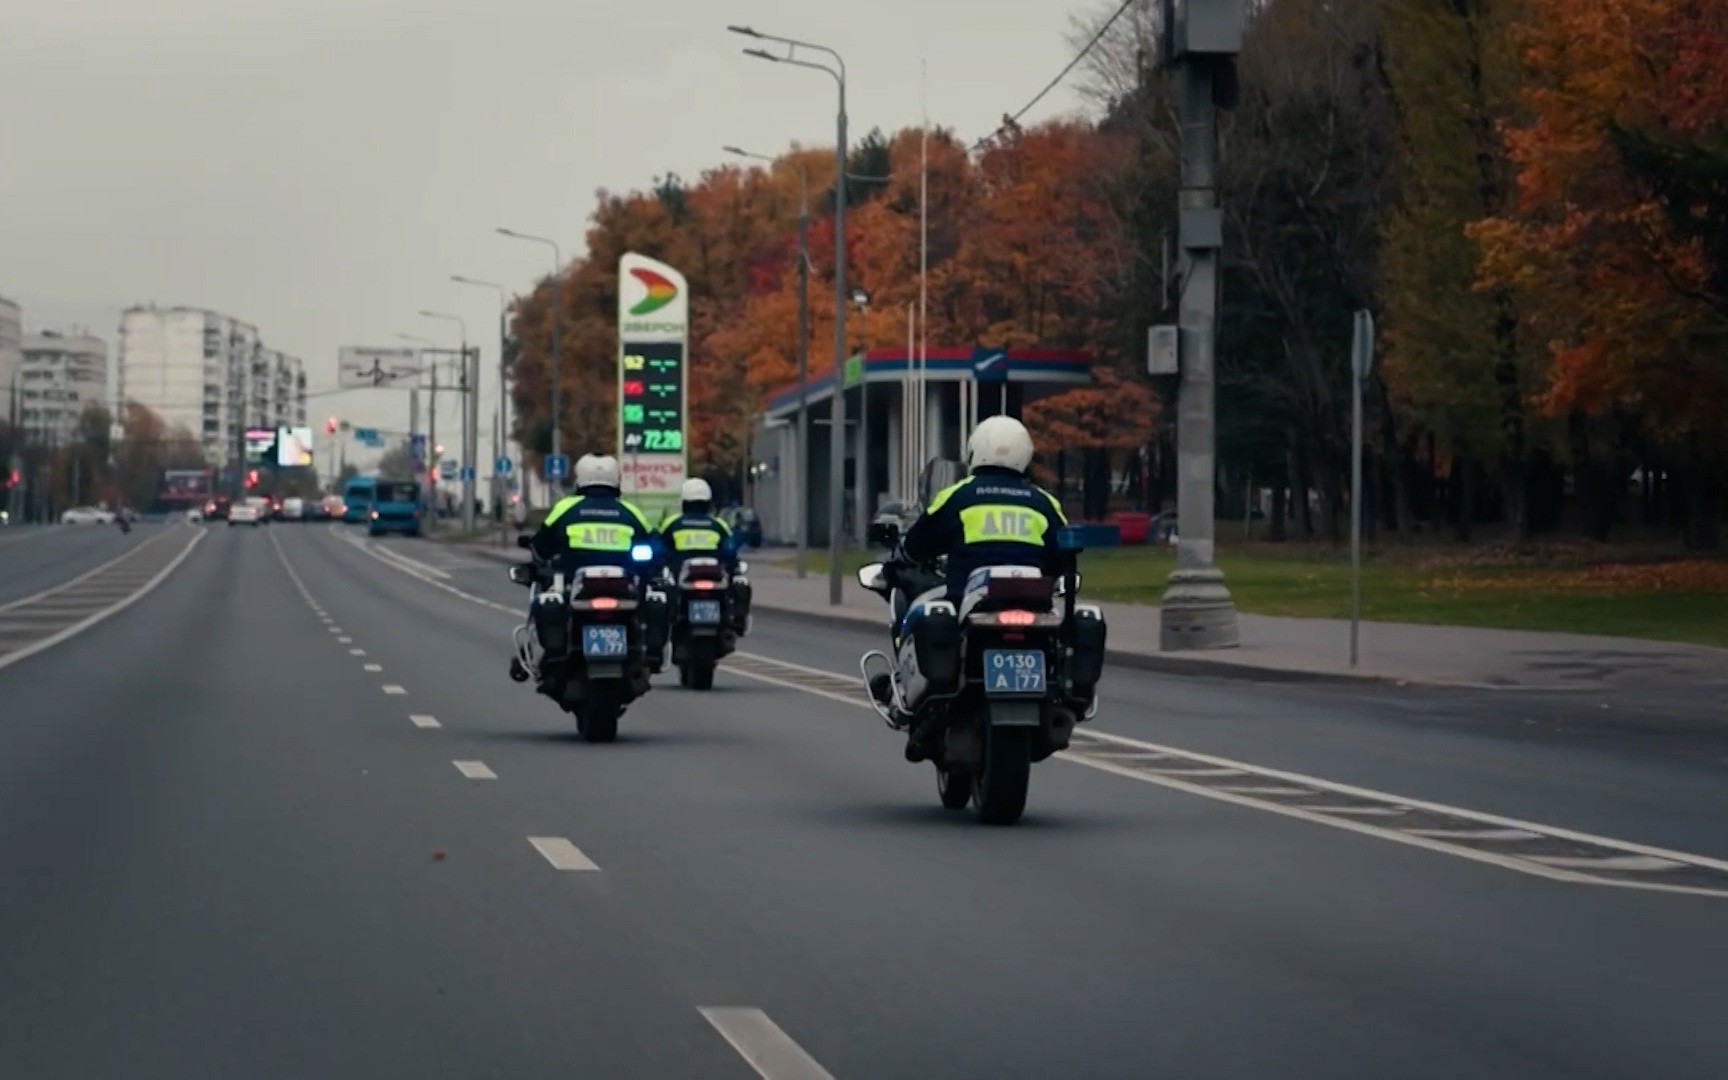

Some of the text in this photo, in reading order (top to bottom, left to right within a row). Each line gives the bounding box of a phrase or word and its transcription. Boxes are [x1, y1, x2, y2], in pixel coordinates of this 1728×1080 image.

[981, 511, 1033, 536] ДПС
[582, 527, 618, 545] ДПС
[609, 643, 623, 652] 77
[993, 653, 1036, 668] 0130
[1020, 675, 1041, 688] 77
